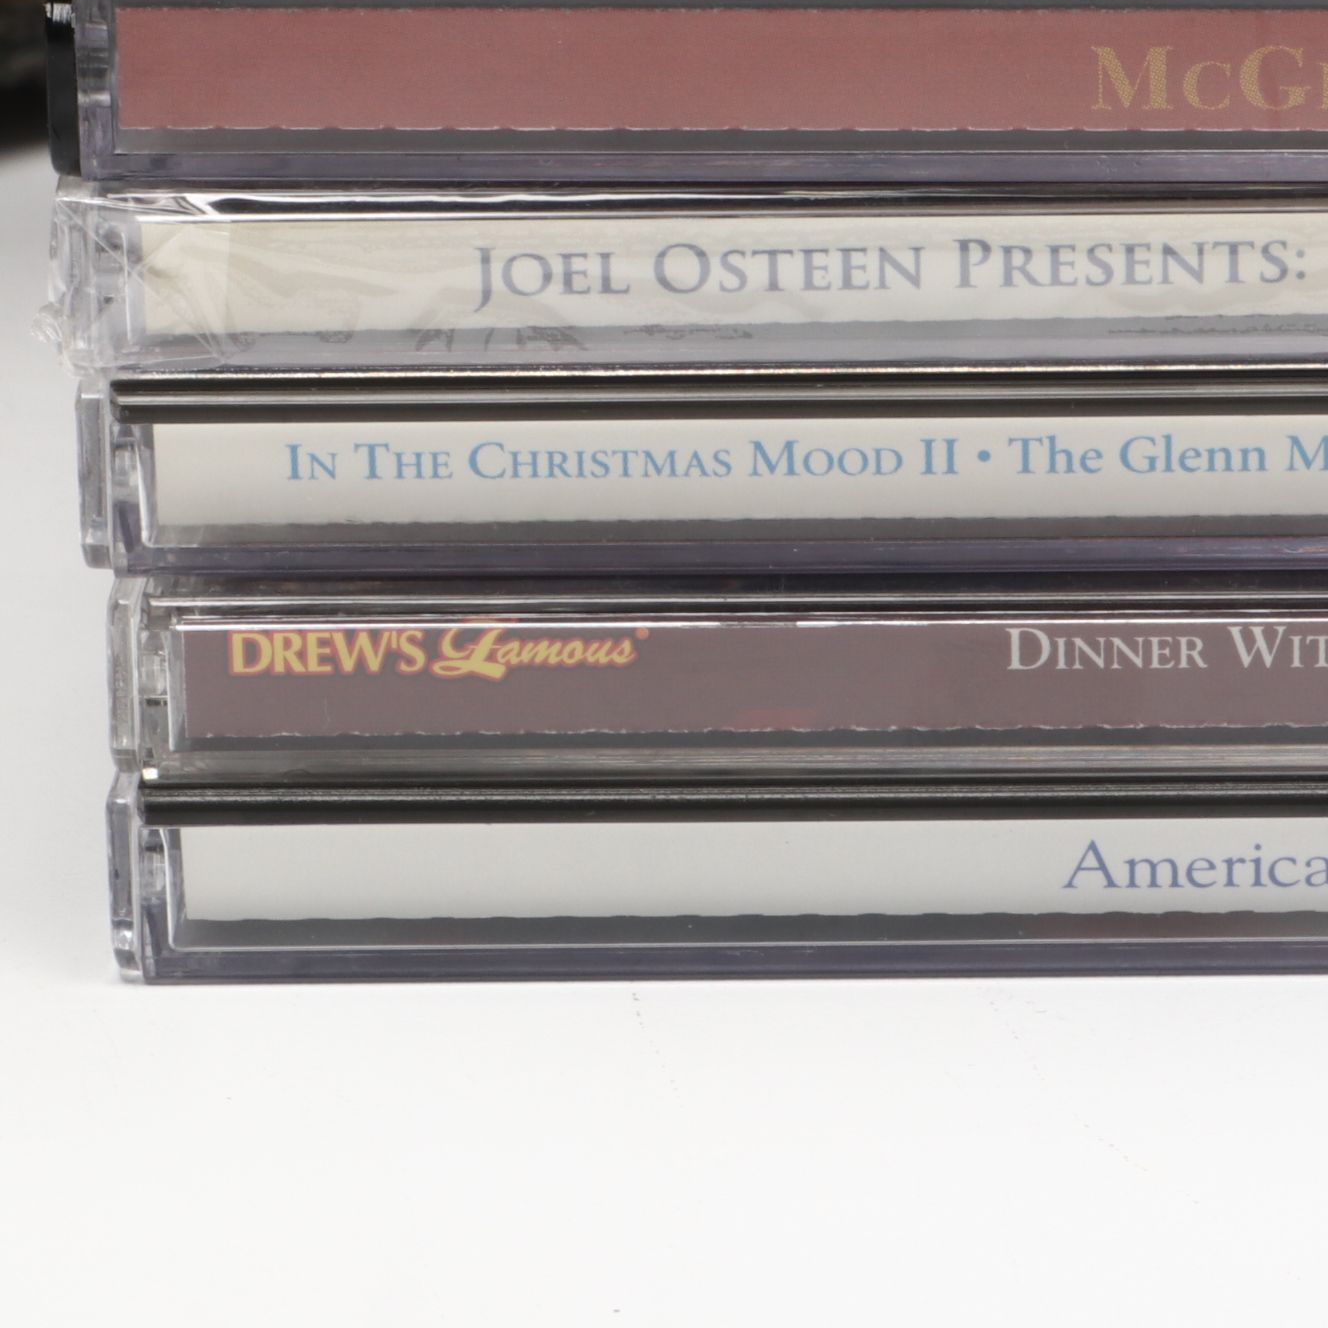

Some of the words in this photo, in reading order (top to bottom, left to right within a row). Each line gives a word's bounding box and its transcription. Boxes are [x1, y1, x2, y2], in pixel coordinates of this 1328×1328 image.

[474, 245, 631, 312] JOEL
[653, 243, 923, 297] OSTEEN
[953, 239, 1307, 290] PRESENTS:
[287, 443, 340, 481] IN
[353, 443, 454, 480] THE
[467, 441, 732, 479] CHRISTMAS
[749, 439, 904, 477] MOOD
[920, 438, 958, 475] II
[1008, 437, 1103, 475] The
[1119, 433, 1268, 474] Glenn
[230, 628, 425, 674] DREW'S
[1005, 626, 1208, 671] DINNER
